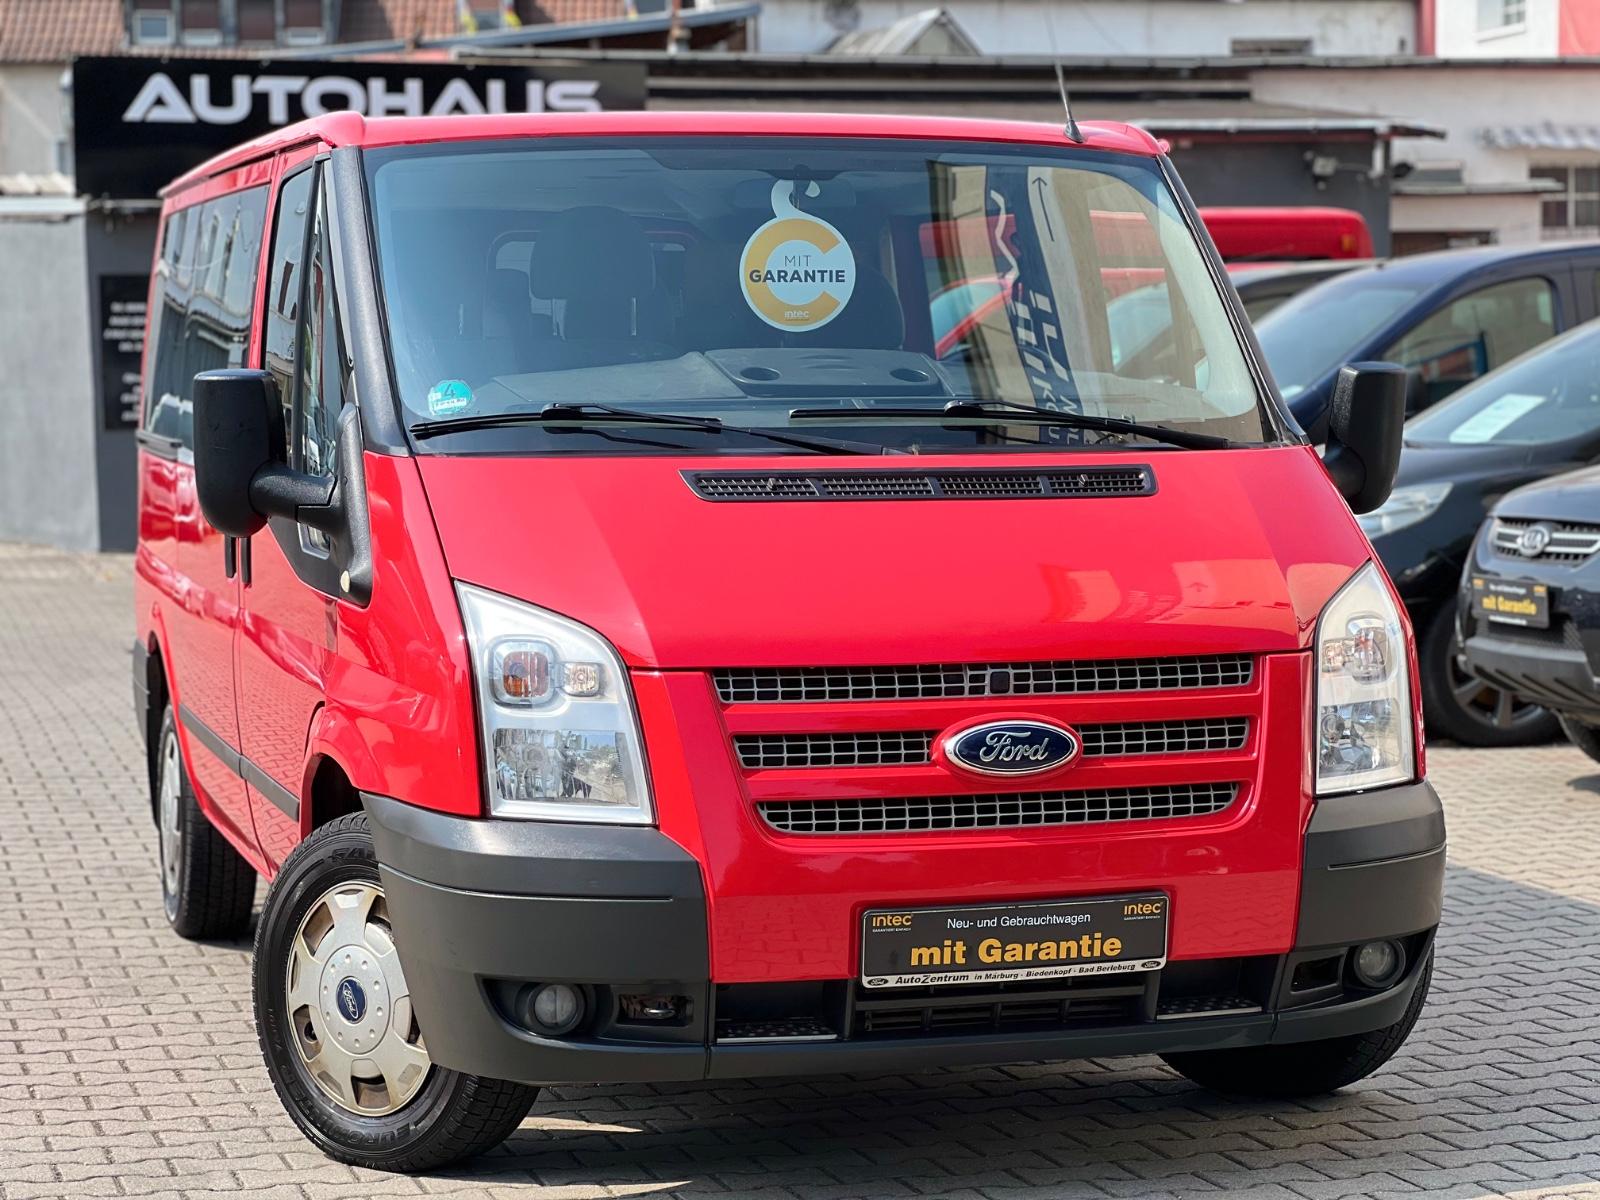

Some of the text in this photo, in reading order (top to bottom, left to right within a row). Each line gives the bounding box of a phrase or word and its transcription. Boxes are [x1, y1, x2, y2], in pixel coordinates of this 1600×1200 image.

[122, 72, 602, 125] AUTOHAUS
[784, 255, 812, 267] MIT
[749, 269, 846, 283] GARANTIE
[784, 310, 809, 318] intec
[980, 731, 1050, 762] Ford
[1124, 902, 1161, 915] intec
[872, 914, 912, 927] intec
[947, 914, 1091, 929] Neu- und Gebrauchtwagen
[910, 932, 1122, 966] mit Garantie
[895, 974, 970, 985] AutoZentrum
[985, 972, 1019, 981] Marburg
[1026, 967, 1073, 978] Biedenkopf
[1079, 966, 1095, 974] Bad
[1096, 963, 1137, 973] Berleburg
[342, 989, 357, 1013] Ford
